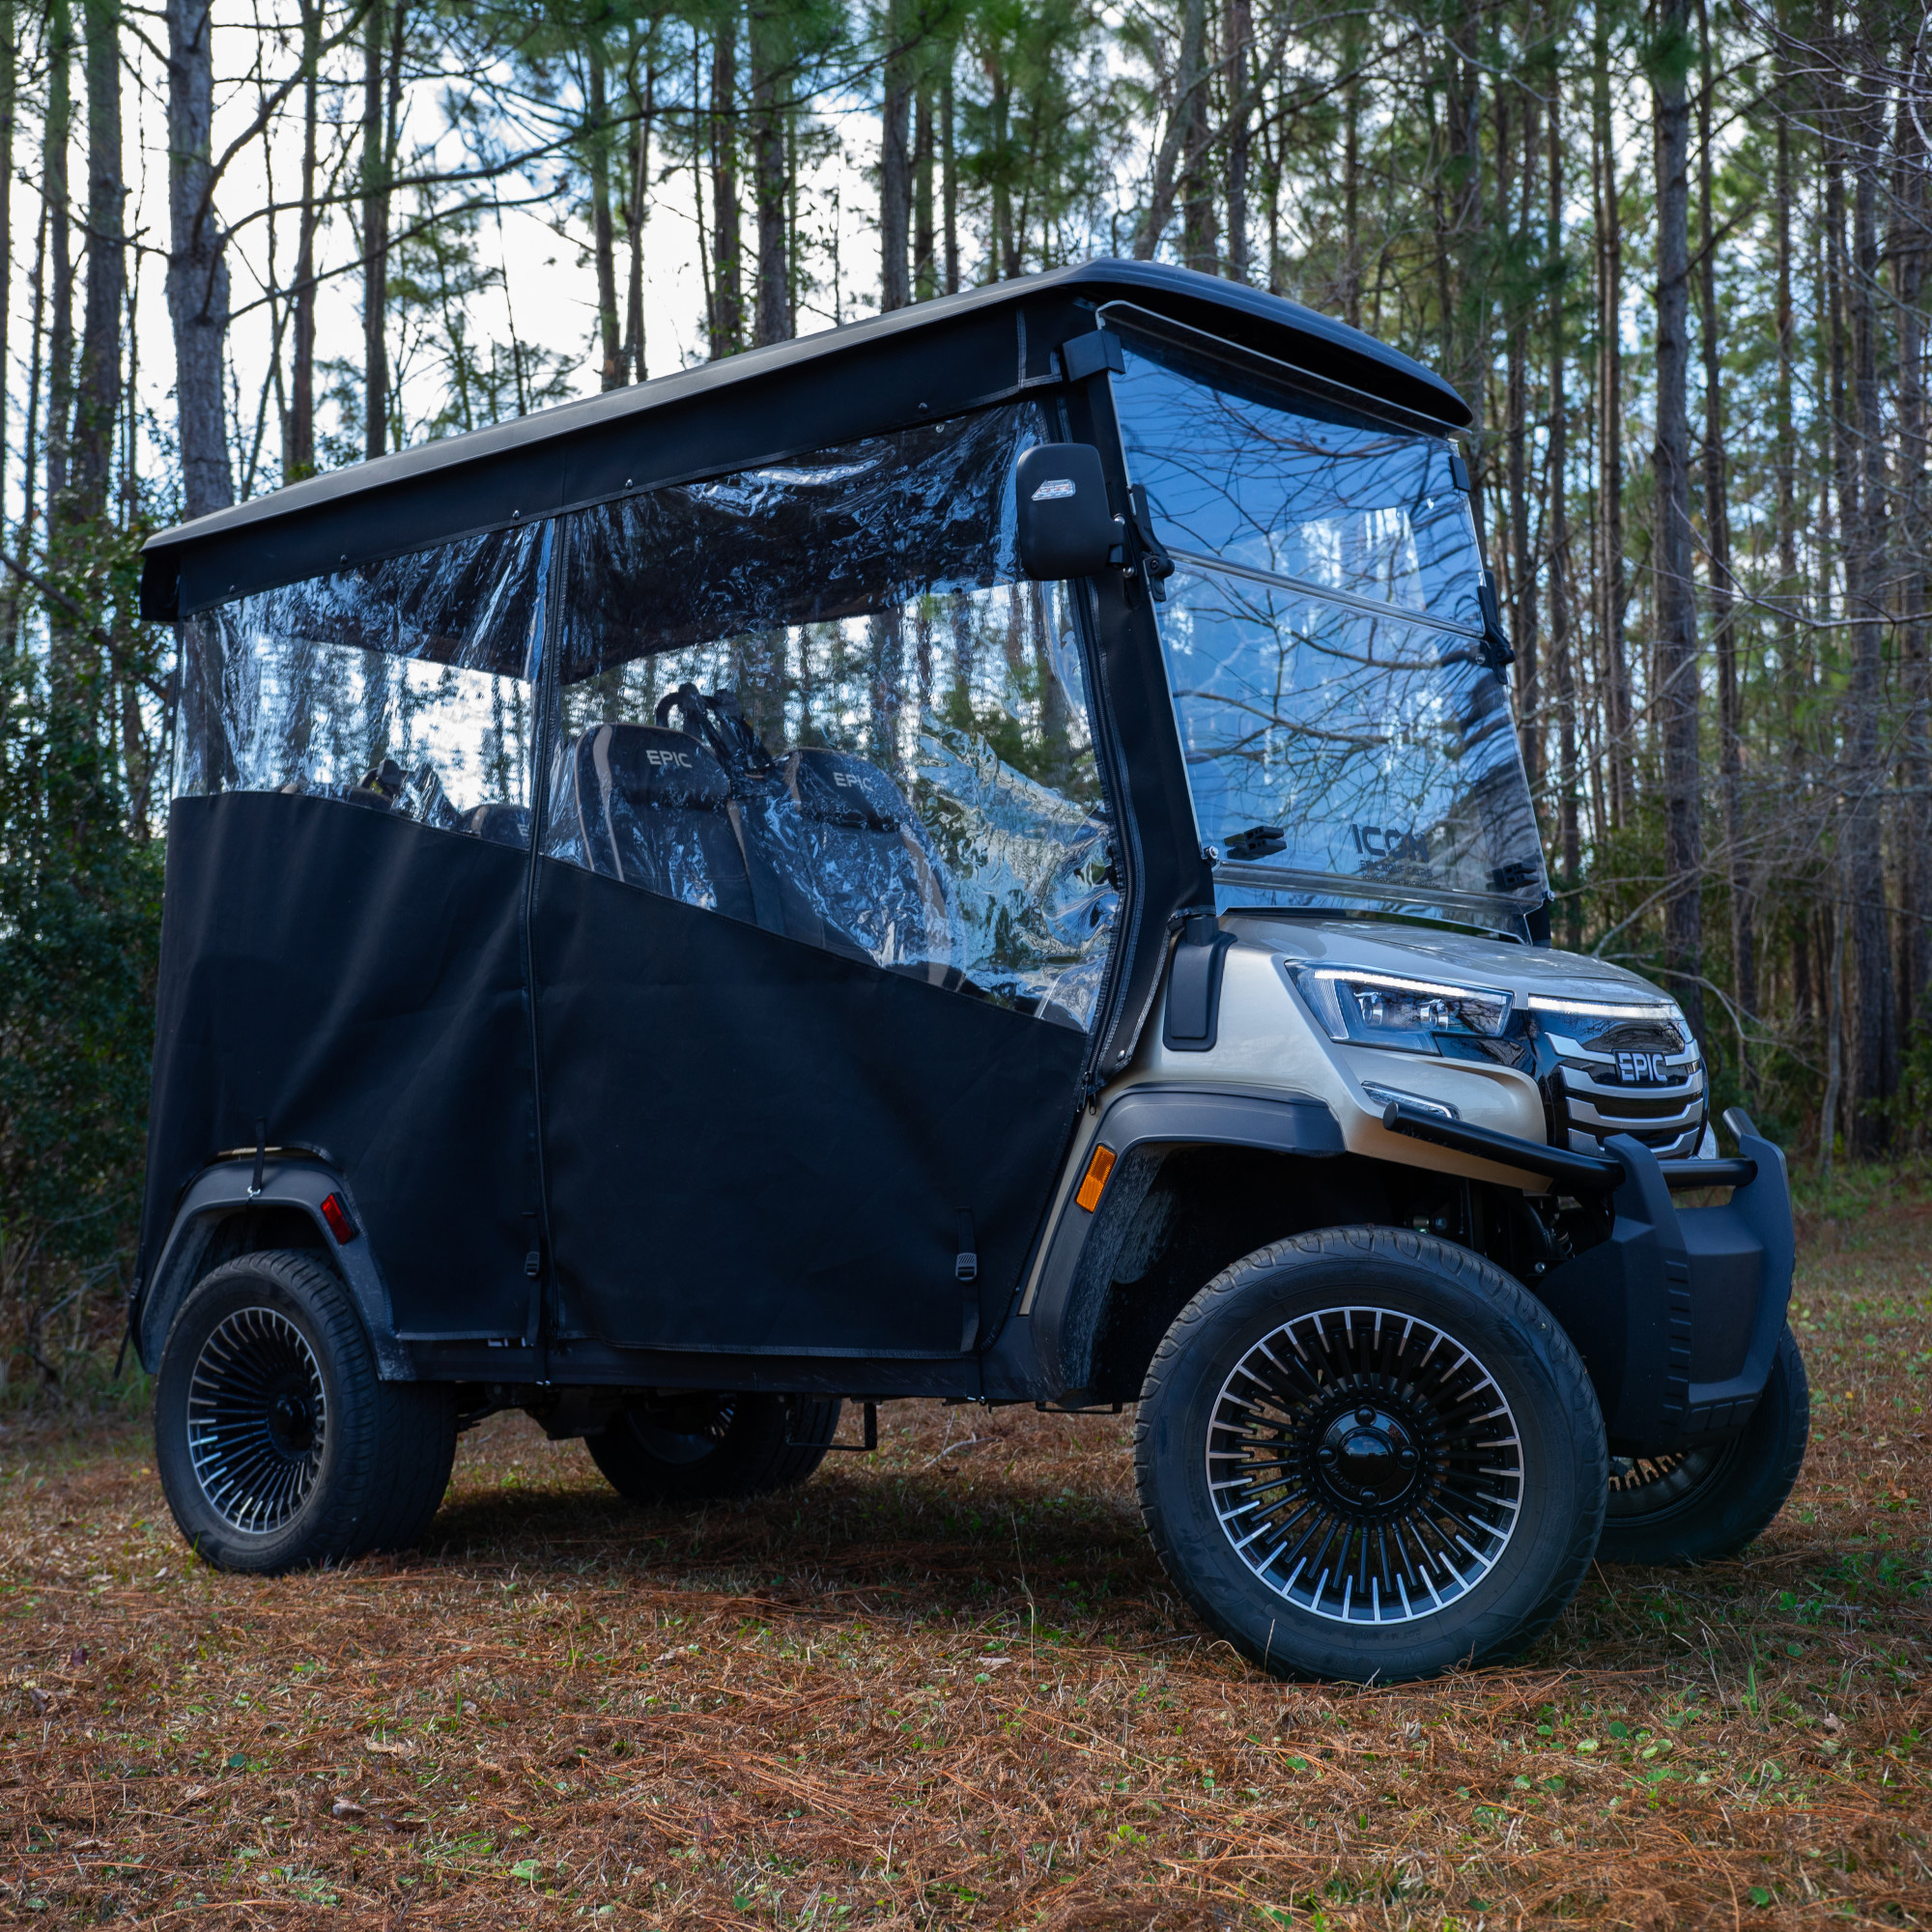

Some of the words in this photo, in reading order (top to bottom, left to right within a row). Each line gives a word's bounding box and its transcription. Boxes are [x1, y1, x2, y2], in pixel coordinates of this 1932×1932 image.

[646, 750, 693, 768] EPIC
[834, 772, 873, 791] EPIC
[1352, 824, 1430, 863] ICON
[1618, 1052, 1667, 1082] EPIC
